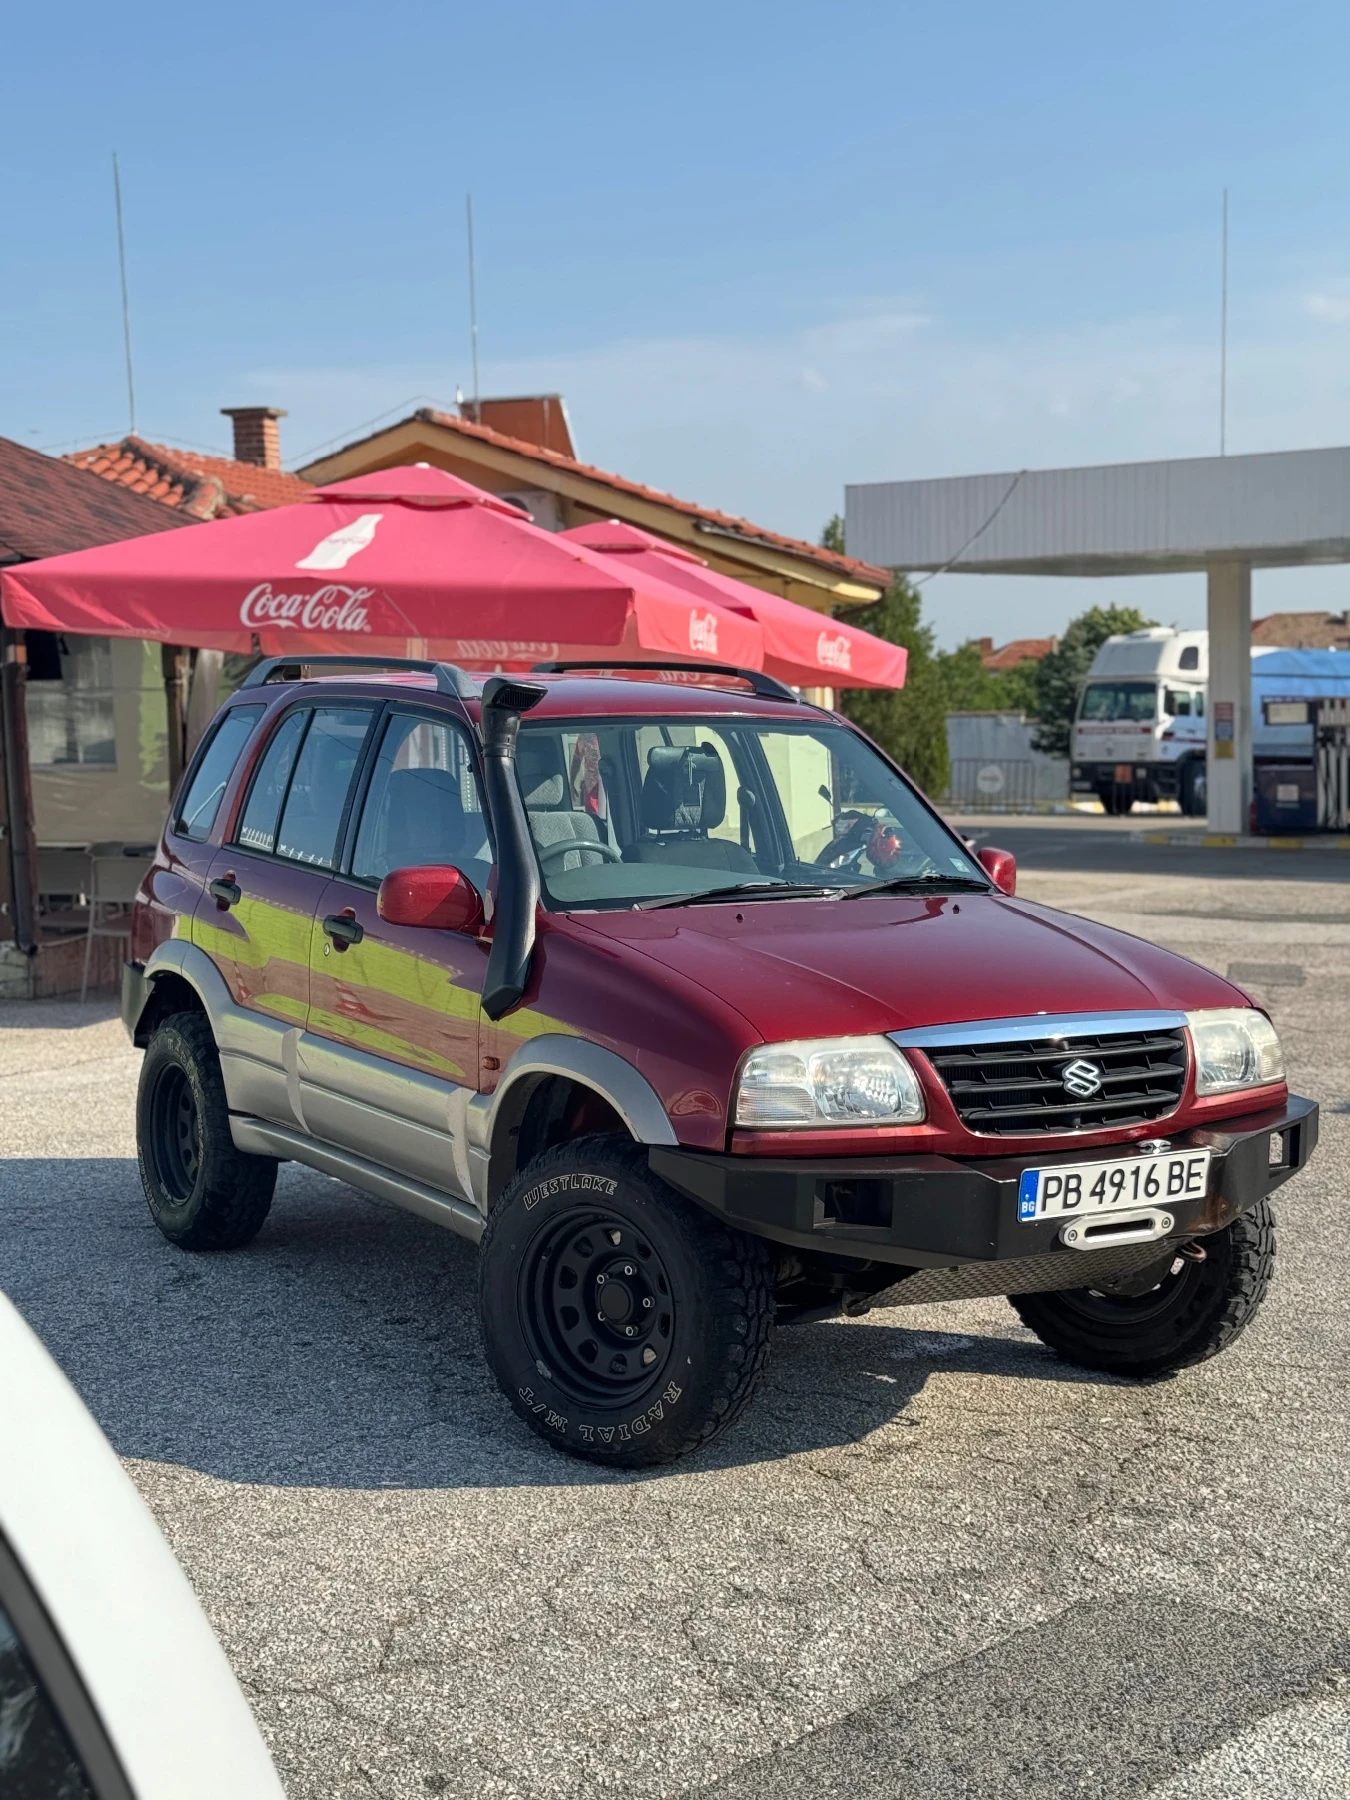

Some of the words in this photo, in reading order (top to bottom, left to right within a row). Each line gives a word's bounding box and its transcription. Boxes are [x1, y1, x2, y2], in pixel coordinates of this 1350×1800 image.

[523, 1173, 618, 1211] WESTLAKE
[1021, 1200, 1036, 1213] BG
[1041, 1173, 1082, 1212] PB
[1089, 1163, 1160, 1205] 4916
[1166, 1158, 1205, 1196] BE
[518, 1387, 568, 1433] M/T
[579, 1381, 682, 1442] RADIAL
